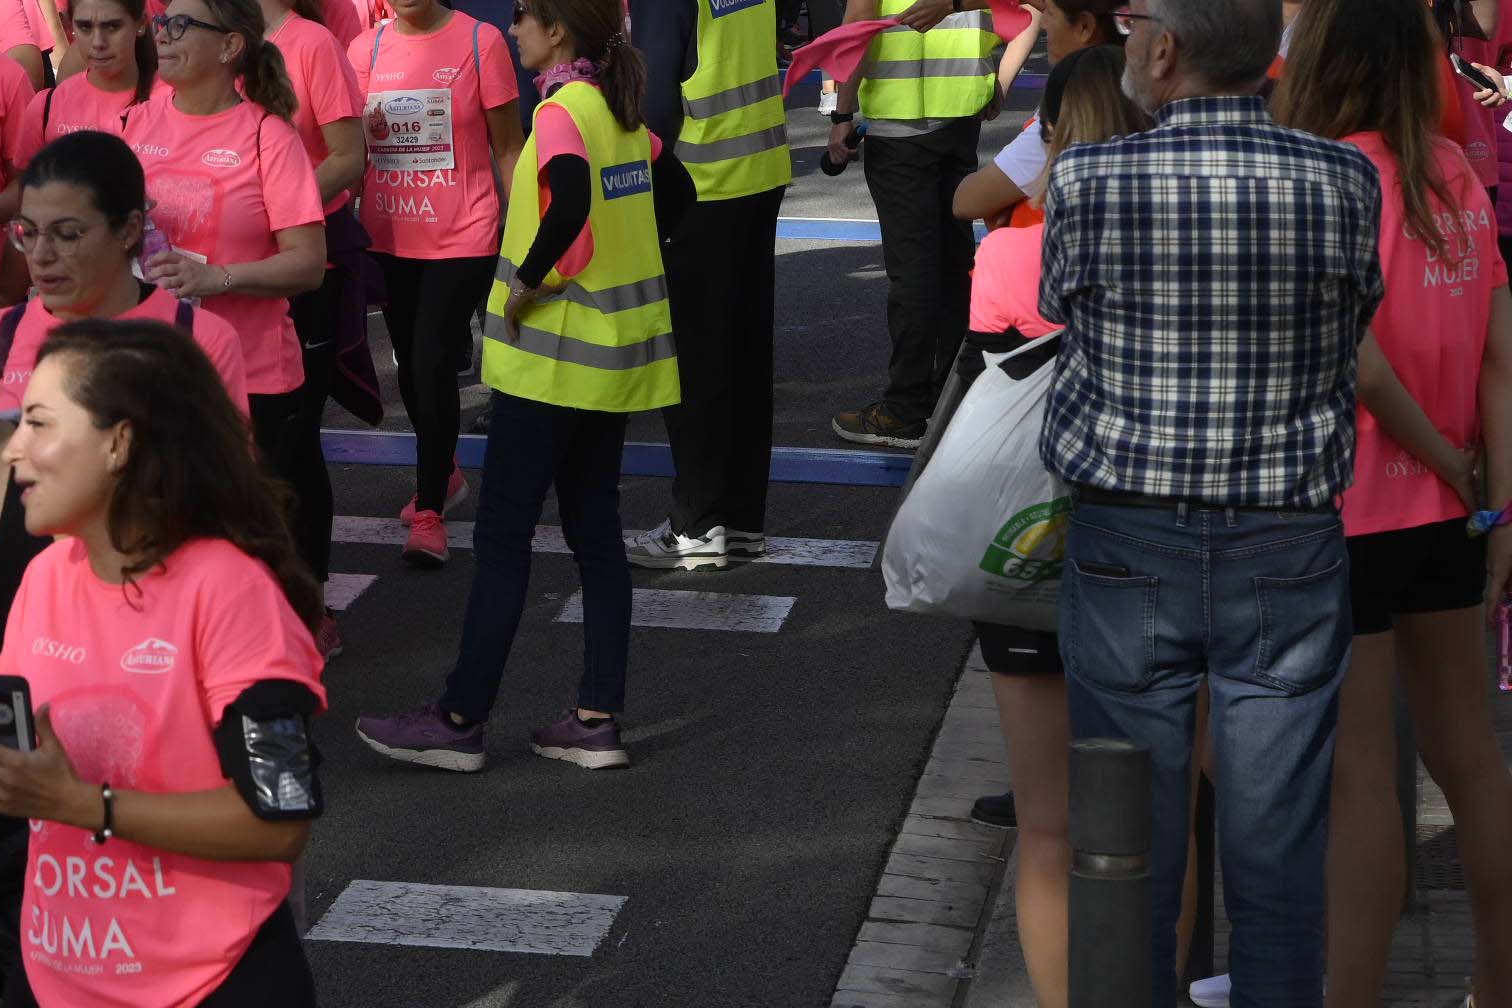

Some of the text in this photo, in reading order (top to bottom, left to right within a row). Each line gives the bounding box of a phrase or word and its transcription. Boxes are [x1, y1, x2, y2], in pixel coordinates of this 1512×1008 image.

[391, 121, 421, 133] 016
[396, 135, 419, 144] 32429
[132, 143, 169, 157] YSHO
[375, 168, 457, 188] DORSAL
[375, 192, 435, 215] SUMA
[27, 906, 135, 960] SUMA
